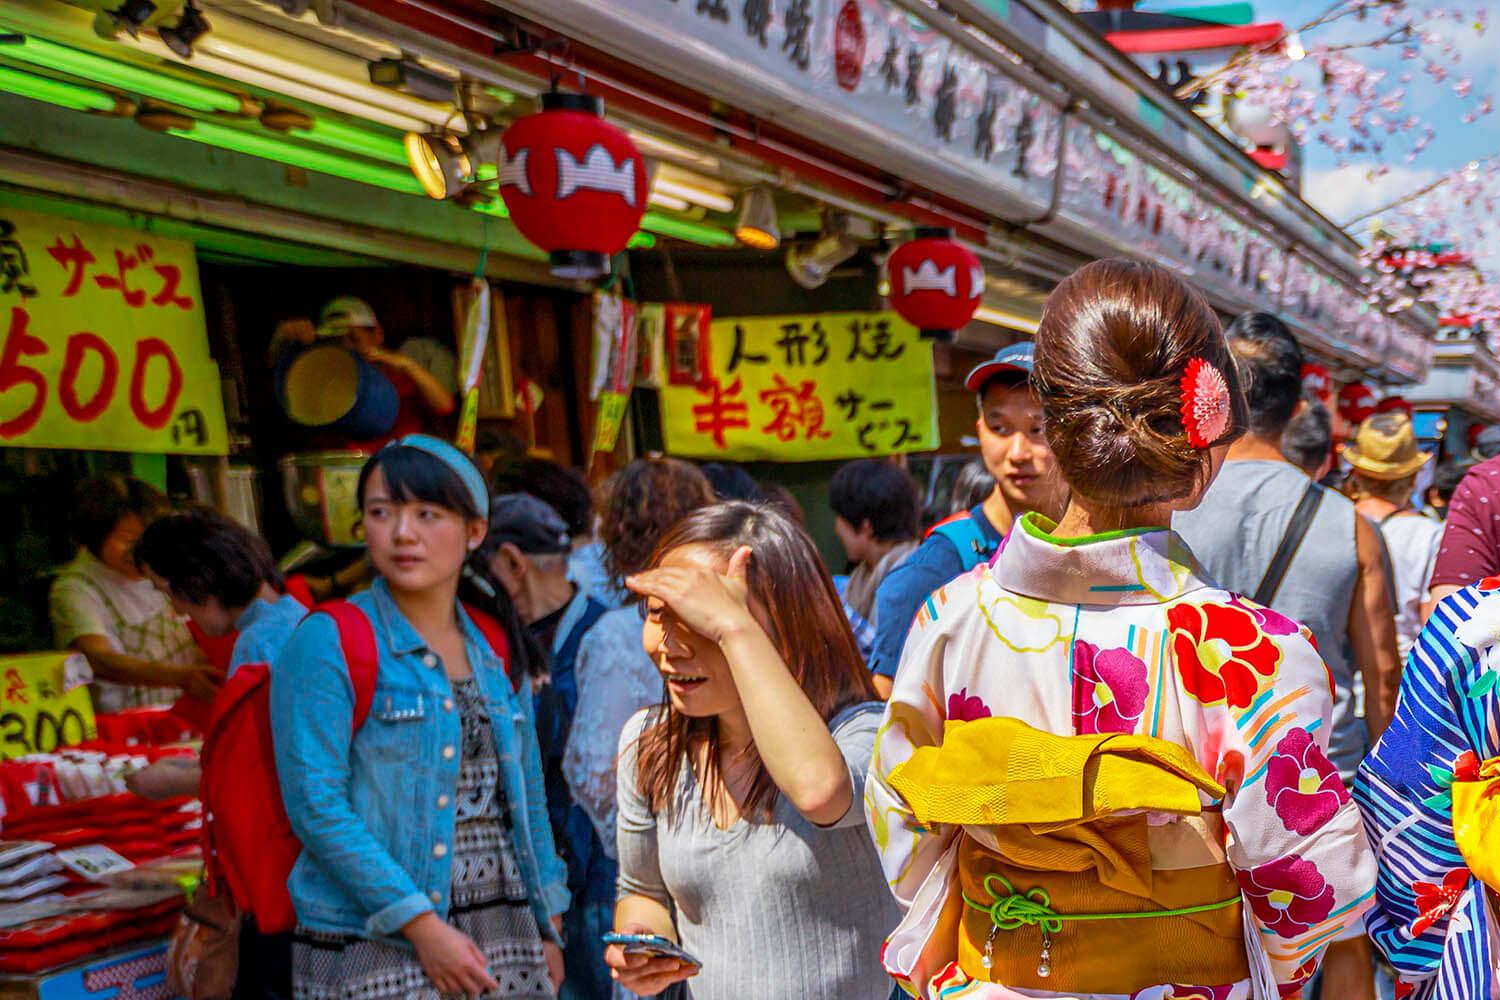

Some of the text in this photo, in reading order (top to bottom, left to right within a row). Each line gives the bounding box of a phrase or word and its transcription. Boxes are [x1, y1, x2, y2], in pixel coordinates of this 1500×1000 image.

[727, 320, 905, 372] 人形焼
[692, 374, 832, 450] 半額
